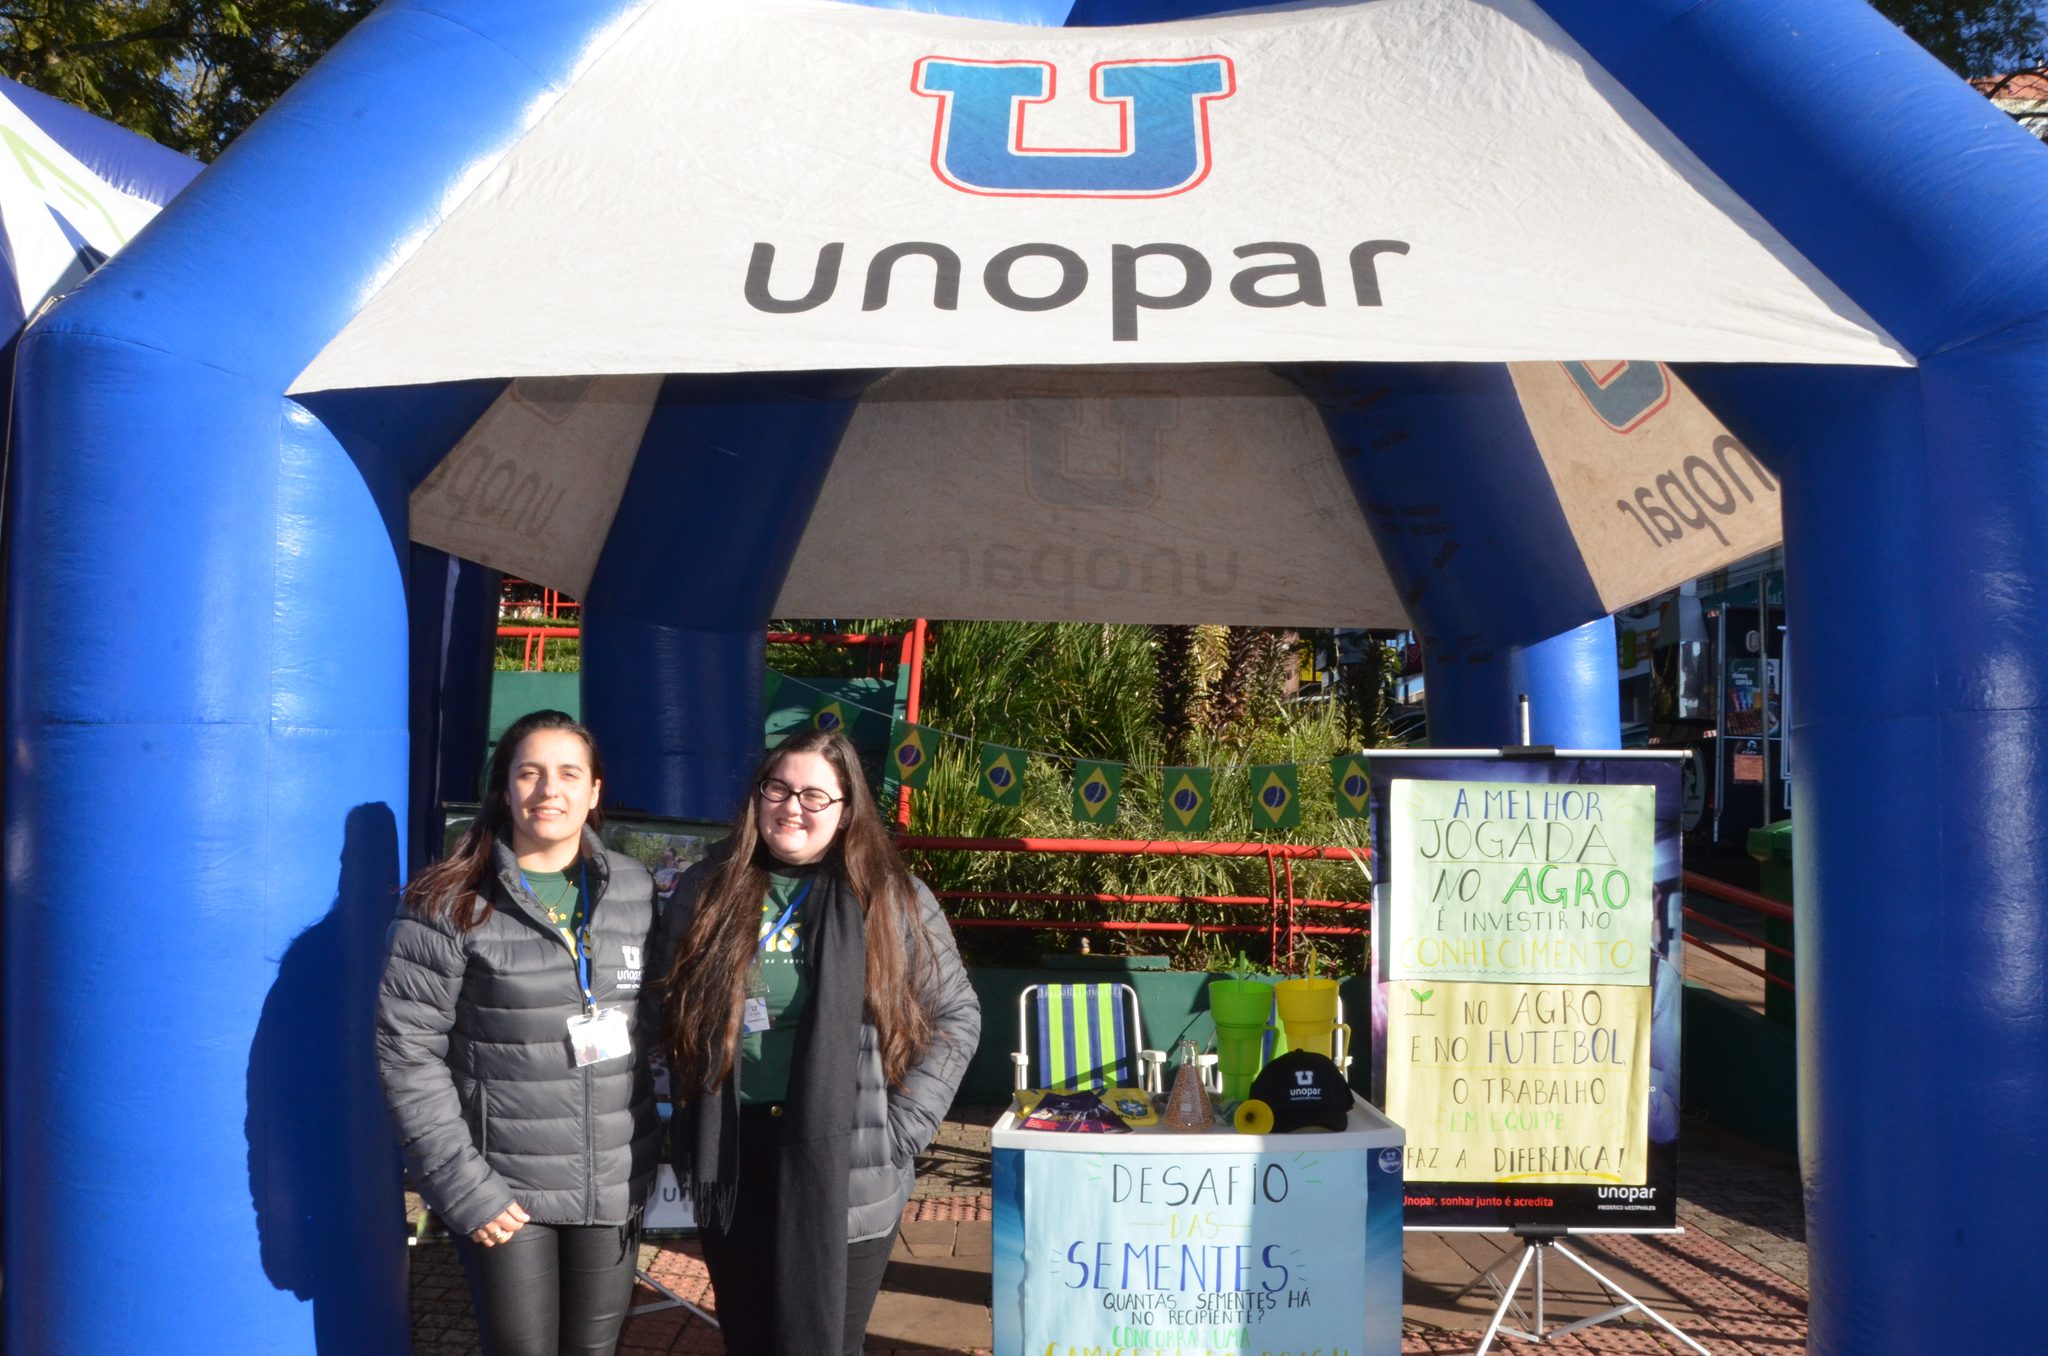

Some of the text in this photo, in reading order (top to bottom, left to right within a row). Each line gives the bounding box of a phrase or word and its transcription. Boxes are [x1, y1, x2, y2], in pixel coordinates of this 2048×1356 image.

[744, 240, 1411, 341] unopar
[1453, 788, 1603, 821] A MELHOR
[1420, 818, 1617, 863] JOGADA
[1432, 864, 1631, 910] NO AGRO
[1437, 906, 1611, 932] É INVESTIR NO
[1401, 936, 1635, 970] CONHECIMENTO
[1464, 990, 1602, 1026] NO AGRO
[1411, 1035, 1422, 1062] E
[1434, 1036, 1468, 1063] NO
[1290, 1087, 1321, 1097] unopar
[1453, 1077, 1606, 1105] O TRABALHO
[1450, 1111, 1564, 1133] EM EQUIPE
[1407, 1147, 1439, 1169] FAZ
[1455, 1148, 1467, 1169] A
[1440, 1195, 1474, 1207] sonhar
[1475, 1195, 1502, 1208] junto
[1513, 1196, 1554, 1207] acredita
[1597, 1187, 1657, 1203] unopar
[1169, 1211, 1219, 1240] DAS
[1064, 1240, 1289, 1292] SEMENTES
[1103, 1292, 1177, 1312] QUANTAS
[1196, 1290, 1276, 1310] SEMENTES
[1131, 1310, 1265, 1326] NO RECIPIENTE?
[1112, 1326, 1198, 1349] CONCORRA
[1212, 1326, 1250, 1349] UMA
